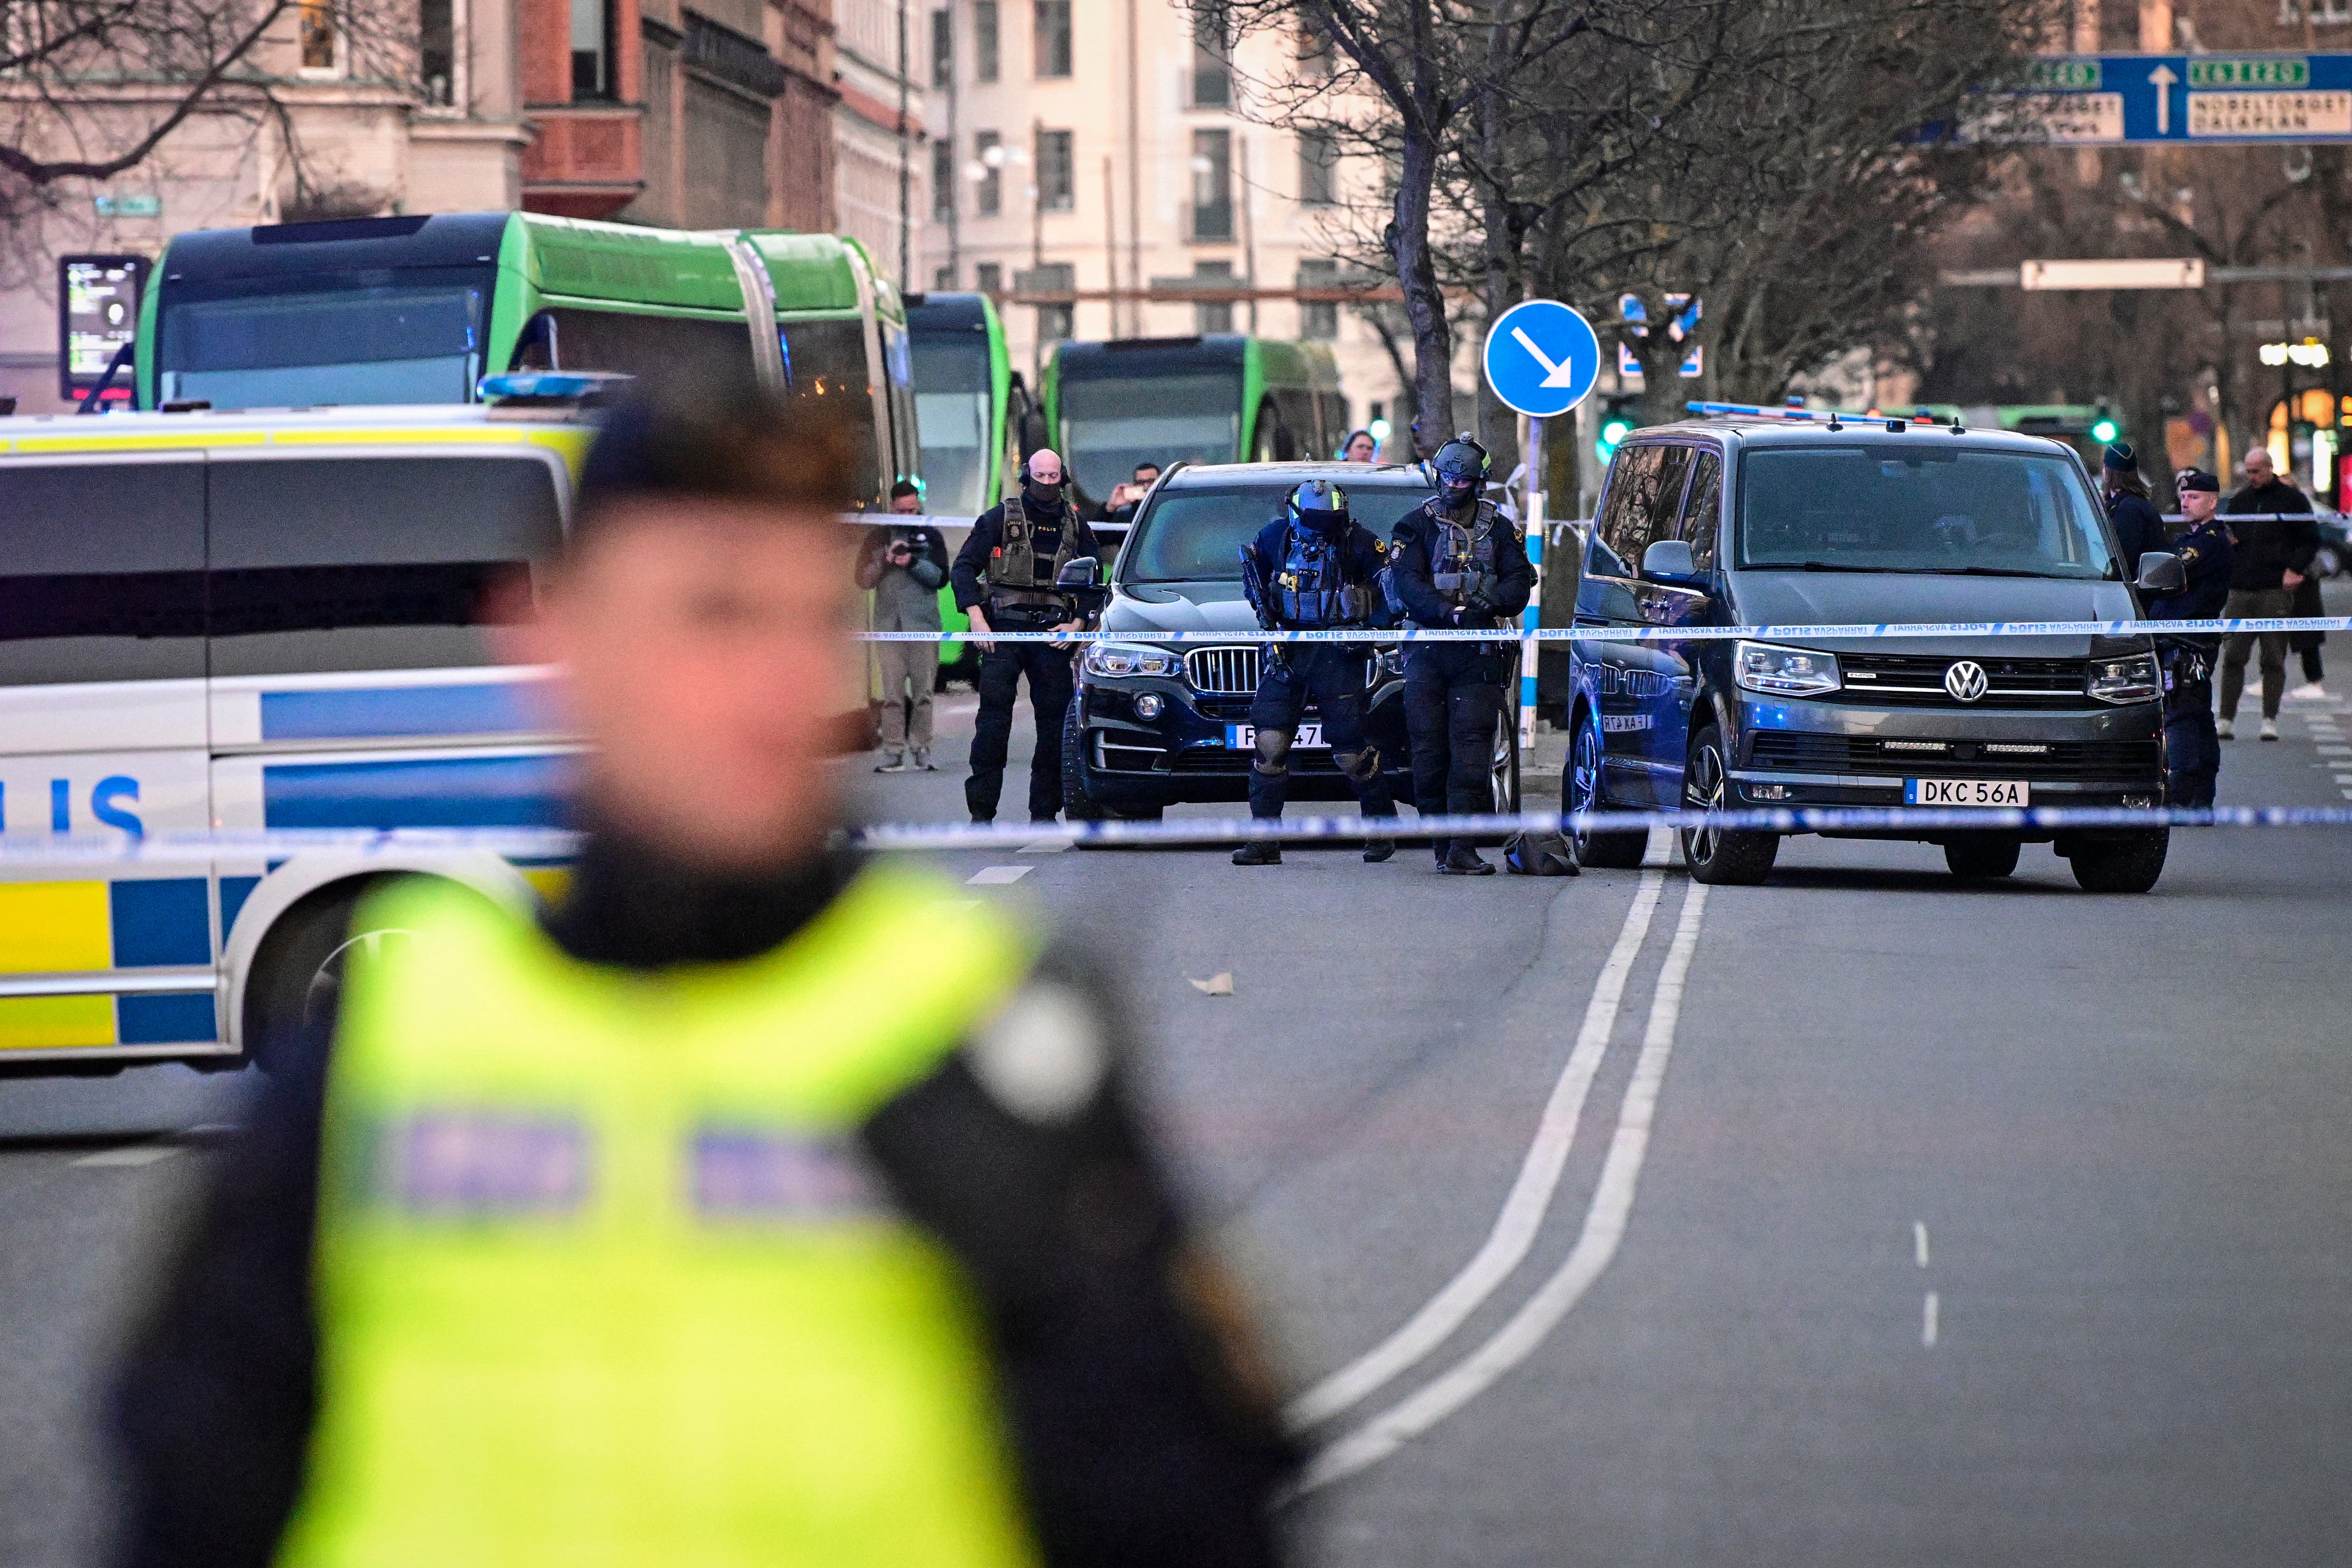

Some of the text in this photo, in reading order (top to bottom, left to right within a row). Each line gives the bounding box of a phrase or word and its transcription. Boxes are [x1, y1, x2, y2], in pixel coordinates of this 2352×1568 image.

[1392, 541, 1405, 549] POLIS
[1926, 782, 1968, 802] DKC
[1976, 783, 2019, 803] 56A
